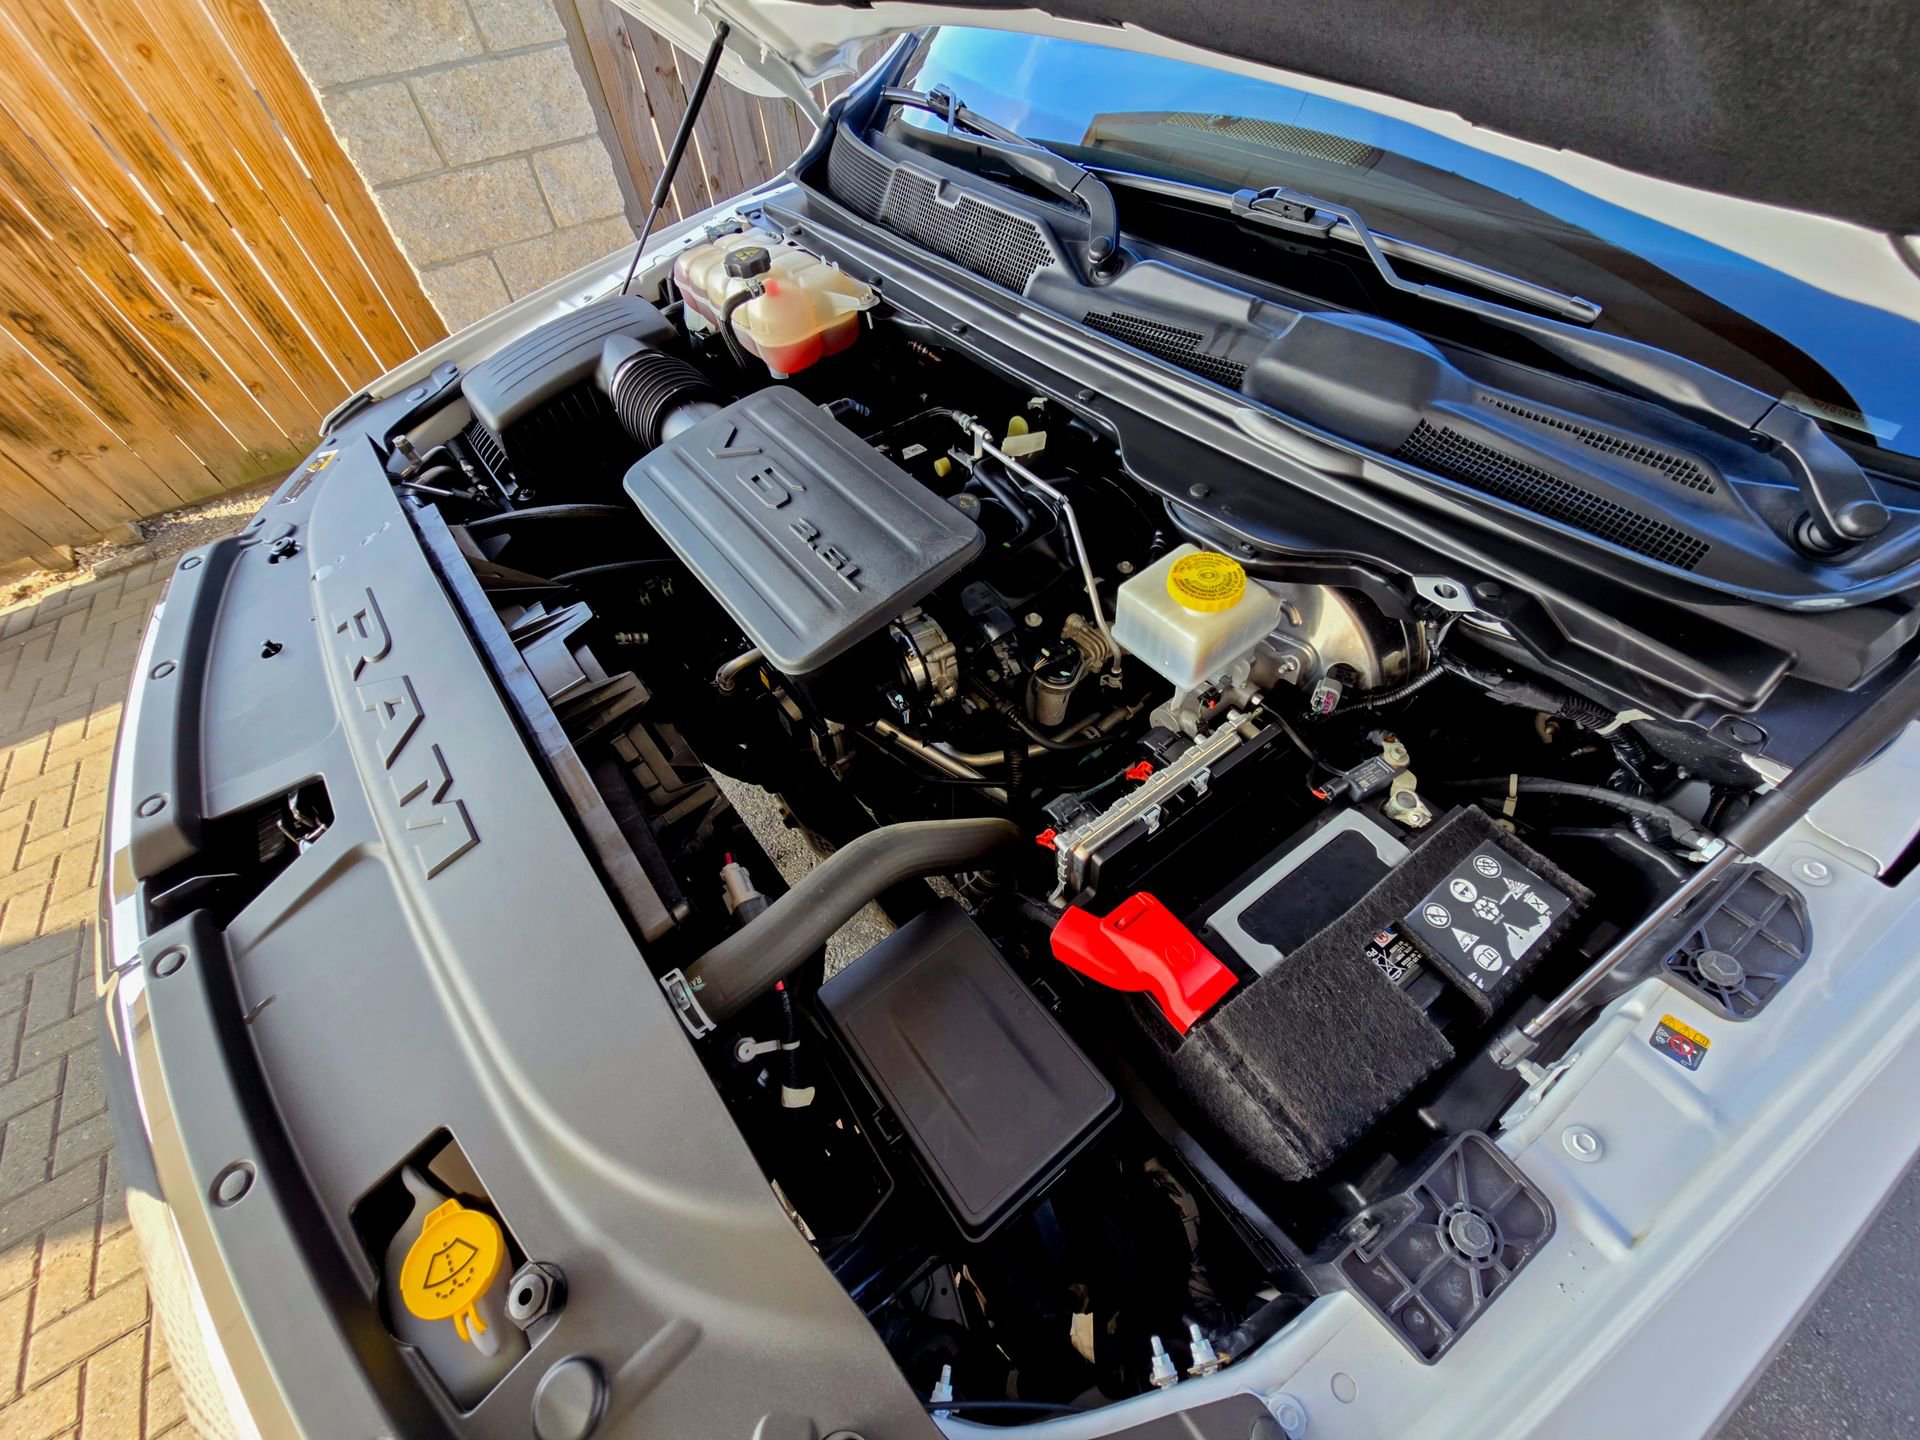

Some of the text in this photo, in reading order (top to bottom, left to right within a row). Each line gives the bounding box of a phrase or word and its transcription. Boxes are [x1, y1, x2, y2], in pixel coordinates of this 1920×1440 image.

[706, 420, 862, 593] V6 3.6L
[330, 587, 481, 881] RAM
[1366, 947, 1379, 958] Pb
